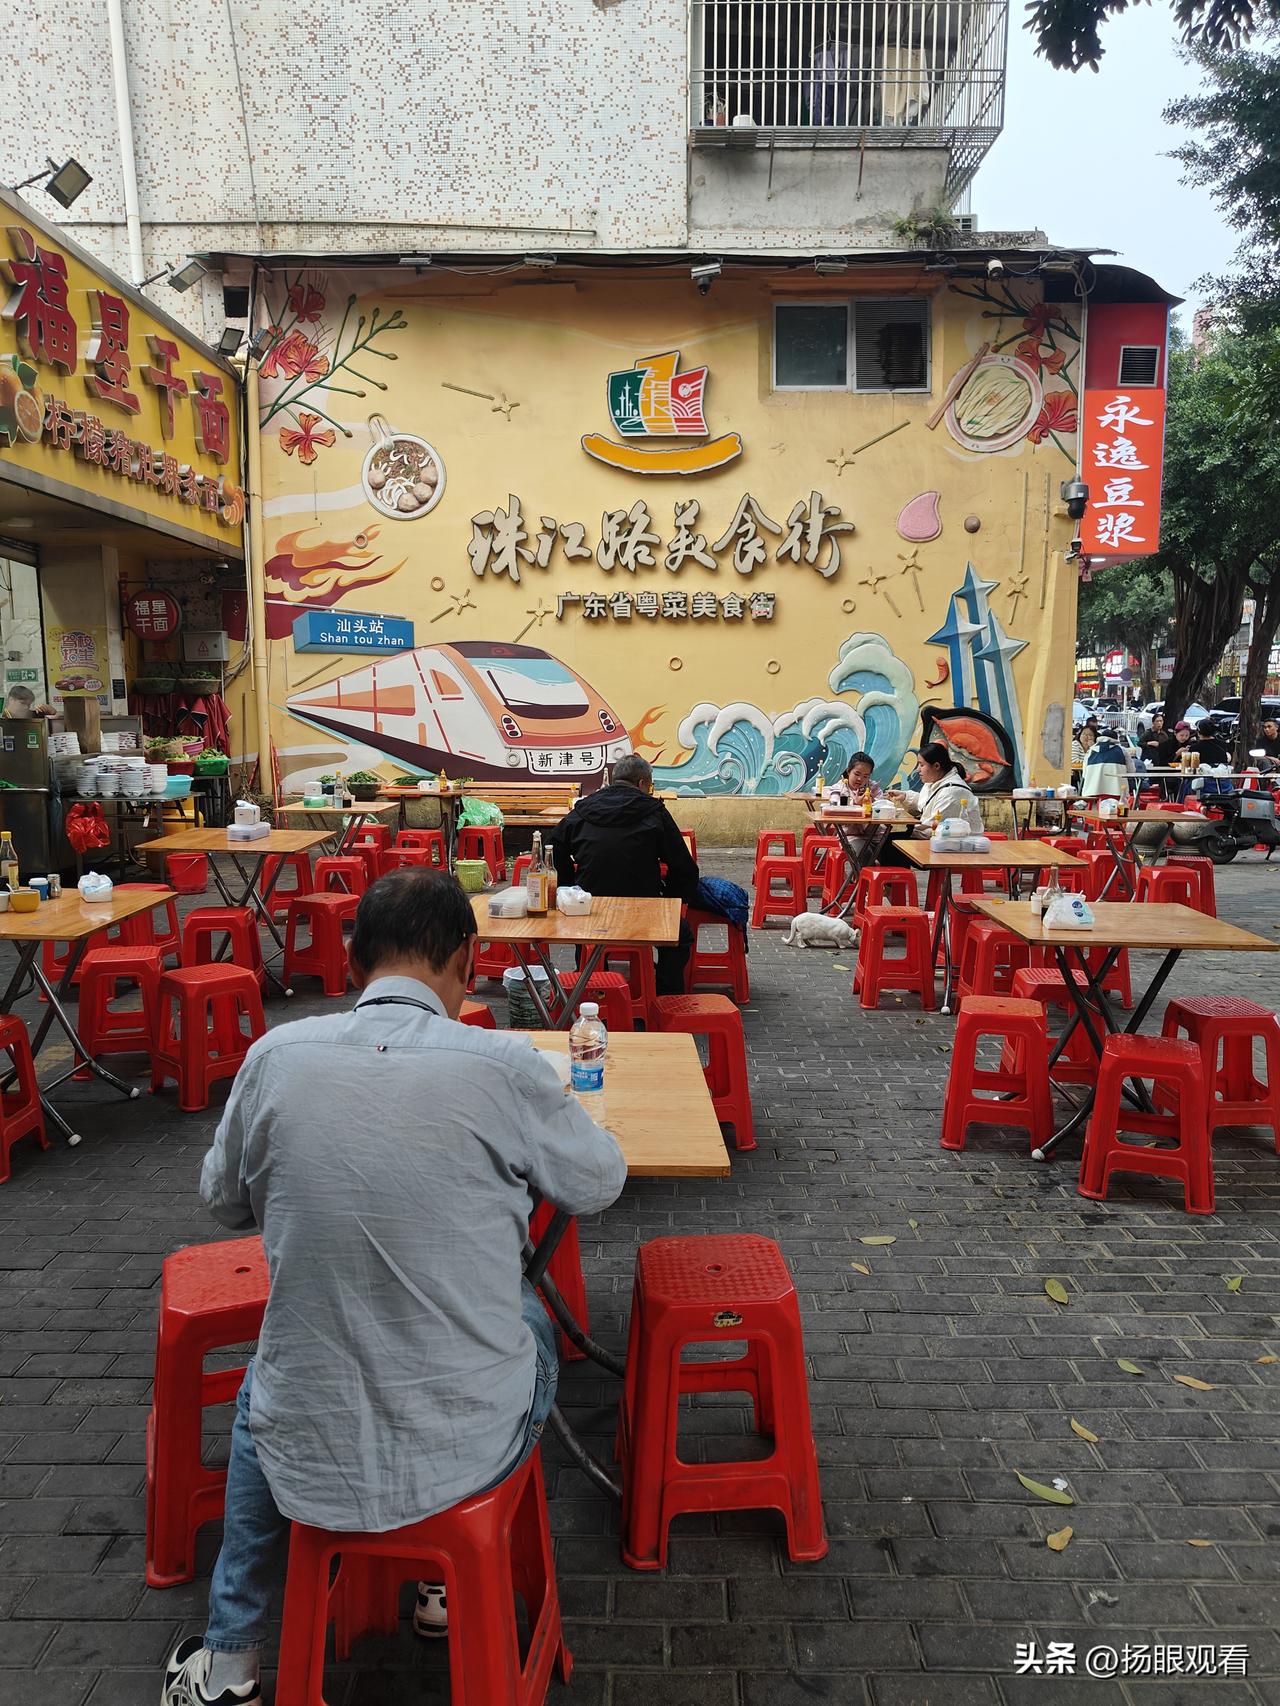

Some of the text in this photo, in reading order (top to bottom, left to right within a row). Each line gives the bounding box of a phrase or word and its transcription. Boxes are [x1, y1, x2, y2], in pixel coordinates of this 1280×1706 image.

[4, 226, 231, 465] 福星干面
[1092, 395, 1155, 548] 永逸豆浆
[466, 490, 856, 584] 珠江路美食街
[134, 600, 167, 616] 福星
[555, 592, 776, 620] 广东省粤菜美食街
[136, 617, 168, 632] 干面
[336, 618, 384, 634] 汕头站
[320, 632, 404, 646] Shan tou zhan
[538, 751, 595, 768] 新津号
